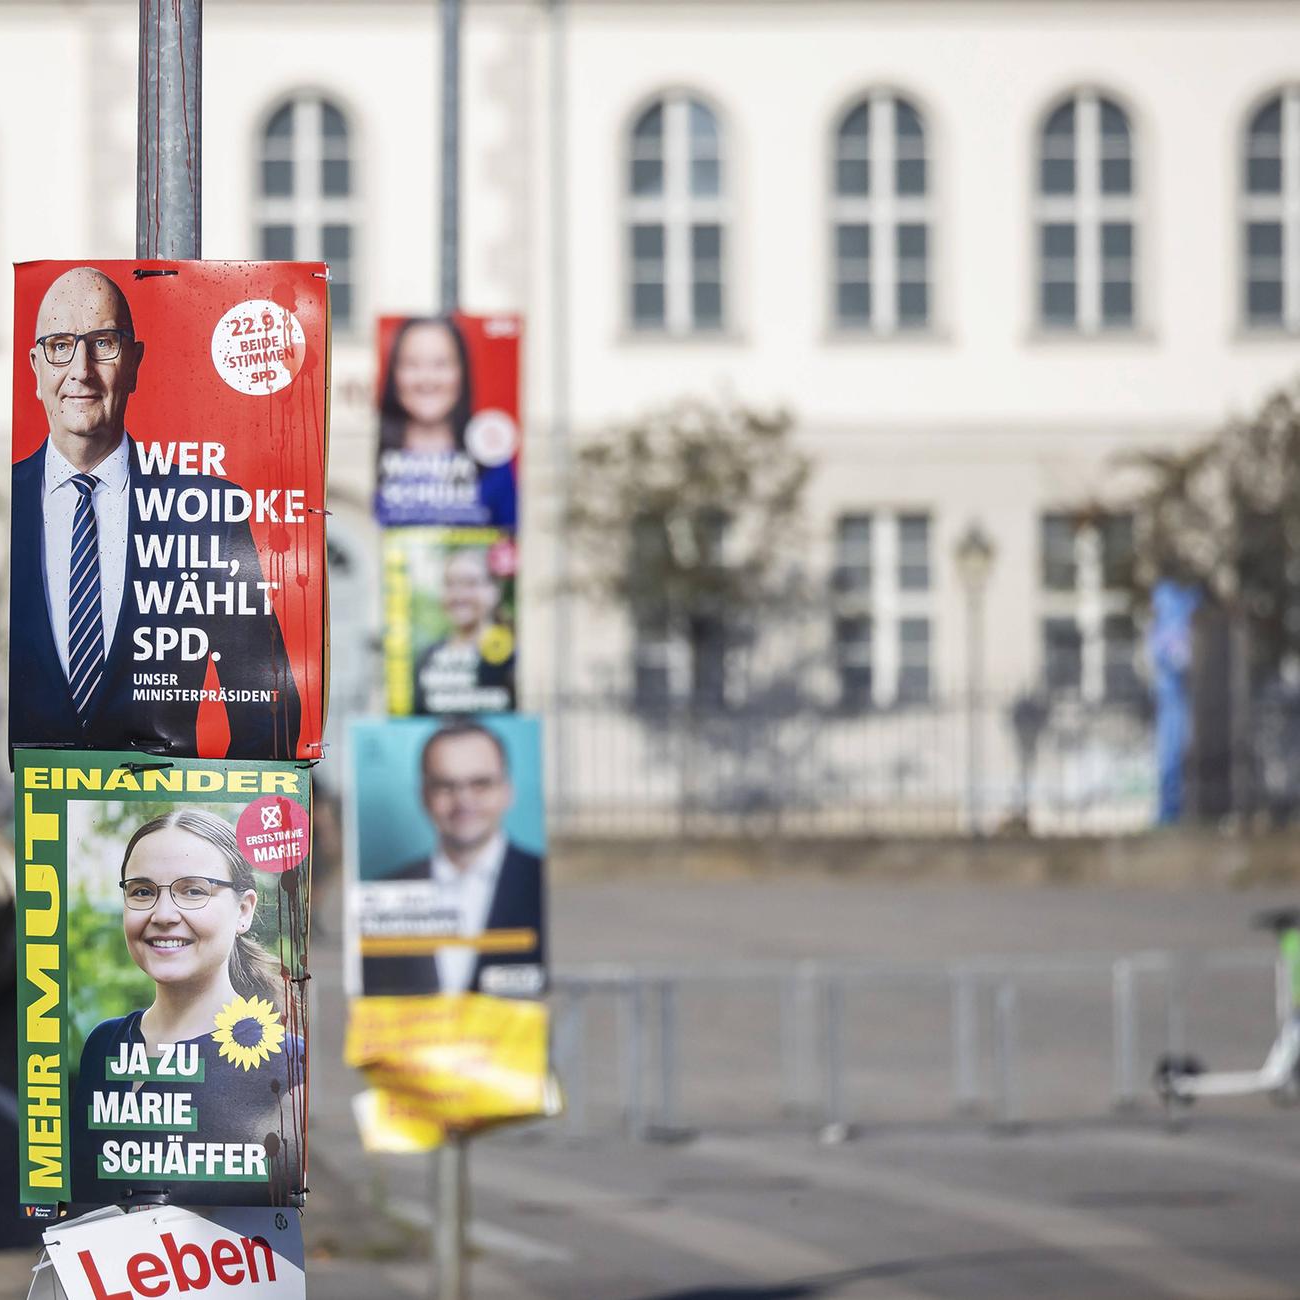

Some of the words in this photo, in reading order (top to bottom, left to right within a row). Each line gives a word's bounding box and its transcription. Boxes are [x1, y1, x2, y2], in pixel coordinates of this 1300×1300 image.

[230, 314, 282, 337] 22.9.
[229, 348, 295, 369] STIMMEN
[240, 336, 280, 353] BEIDE
[251, 370, 277, 384] SPD
[134, 441, 227, 476] WER
[134, 488, 305, 523] WOIDKE
[134, 534, 240, 577] WILL,
[133, 572, 280, 616] WÄHLT
[133, 627, 222, 662] SPD.
[133, 673, 179, 686] UNSER
[133, 686, 280, 703] MINISTERPRÄSIDENT
[24, 766, 301, 794] EINANDER
[253, 842, 302, 863] MARIE
[24, 793, 61, 1043] MUT
[110, 1043, 150, 1075] JA
[156, 1043, 199, 1076] ZU
[27, 1053, 64, 1188] MEHR
[93, 1091, 192, 1125] MARIE
[102, 1135, 267, 1176] SCHÄFFER
[77, 1231, 277, 1300] Leben
